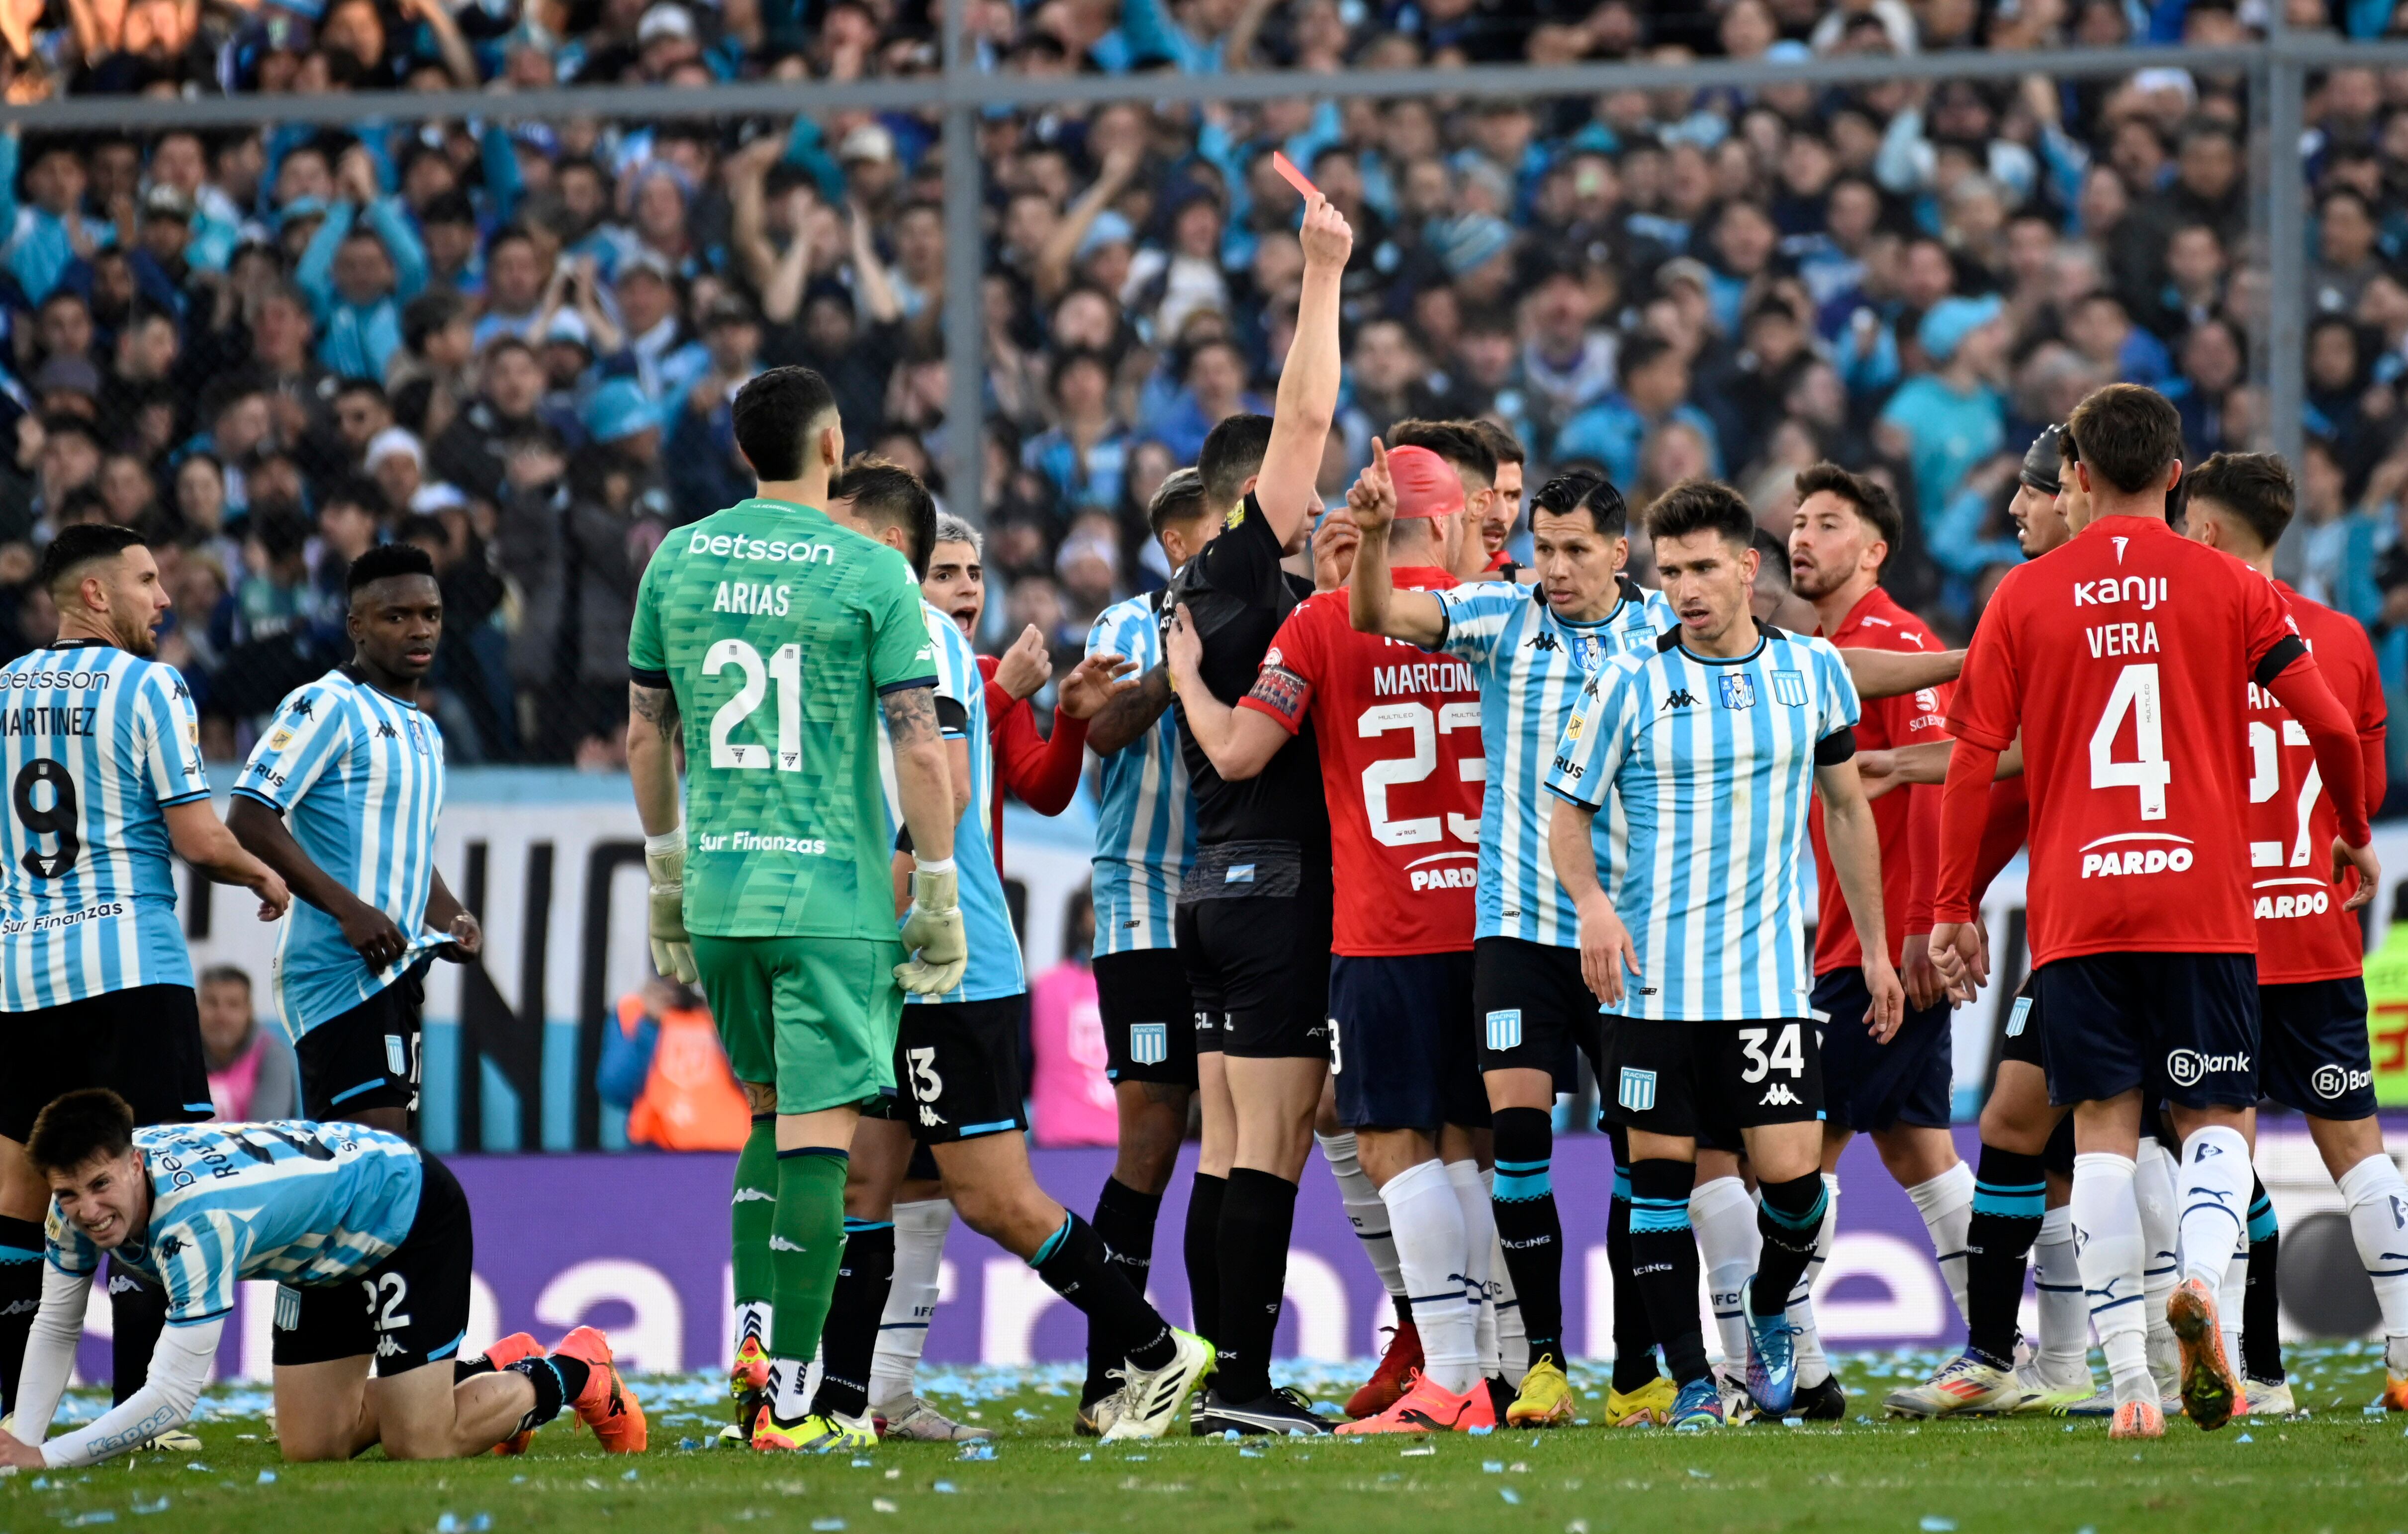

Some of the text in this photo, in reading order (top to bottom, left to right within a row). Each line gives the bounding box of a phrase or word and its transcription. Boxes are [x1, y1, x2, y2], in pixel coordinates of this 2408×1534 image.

[688, 529, 834, 565] betsson
[713, 581, 790, 617] ARIAS
[1624, 628, 1653, 638] RACING
[2086, 622, 2160, 658] VERA
[702, 639, 802, 771] 21
[2090, 664, 2170, 821] 4
[254, 763, 285, 787] RUS
[1358, 702, 1485, 847] 23
[1553, 755, 1583, 779] RUS
[13, 758, 81, 879] 9
[733, 832, 825, 854] Finanzas
[2082, 848, 2194, 878] PARDO
[1, 902, 123, 935] Sur Finanzas
[2254, 891, 2328, 919] ARDO
[1489, 1013, 1518, 1021] RACING
[1739, 1023, 1802, 1084] 34
[1624, 1071, 1652, 1081] RACING
[1501, 1235, 1551, 1249] RACING
[1109, 1251, 1151, 1267] ACIN
[826, 1376, 865, 1392] FOXSOCKS
[87, 1405, 175, 1458] Kappa
